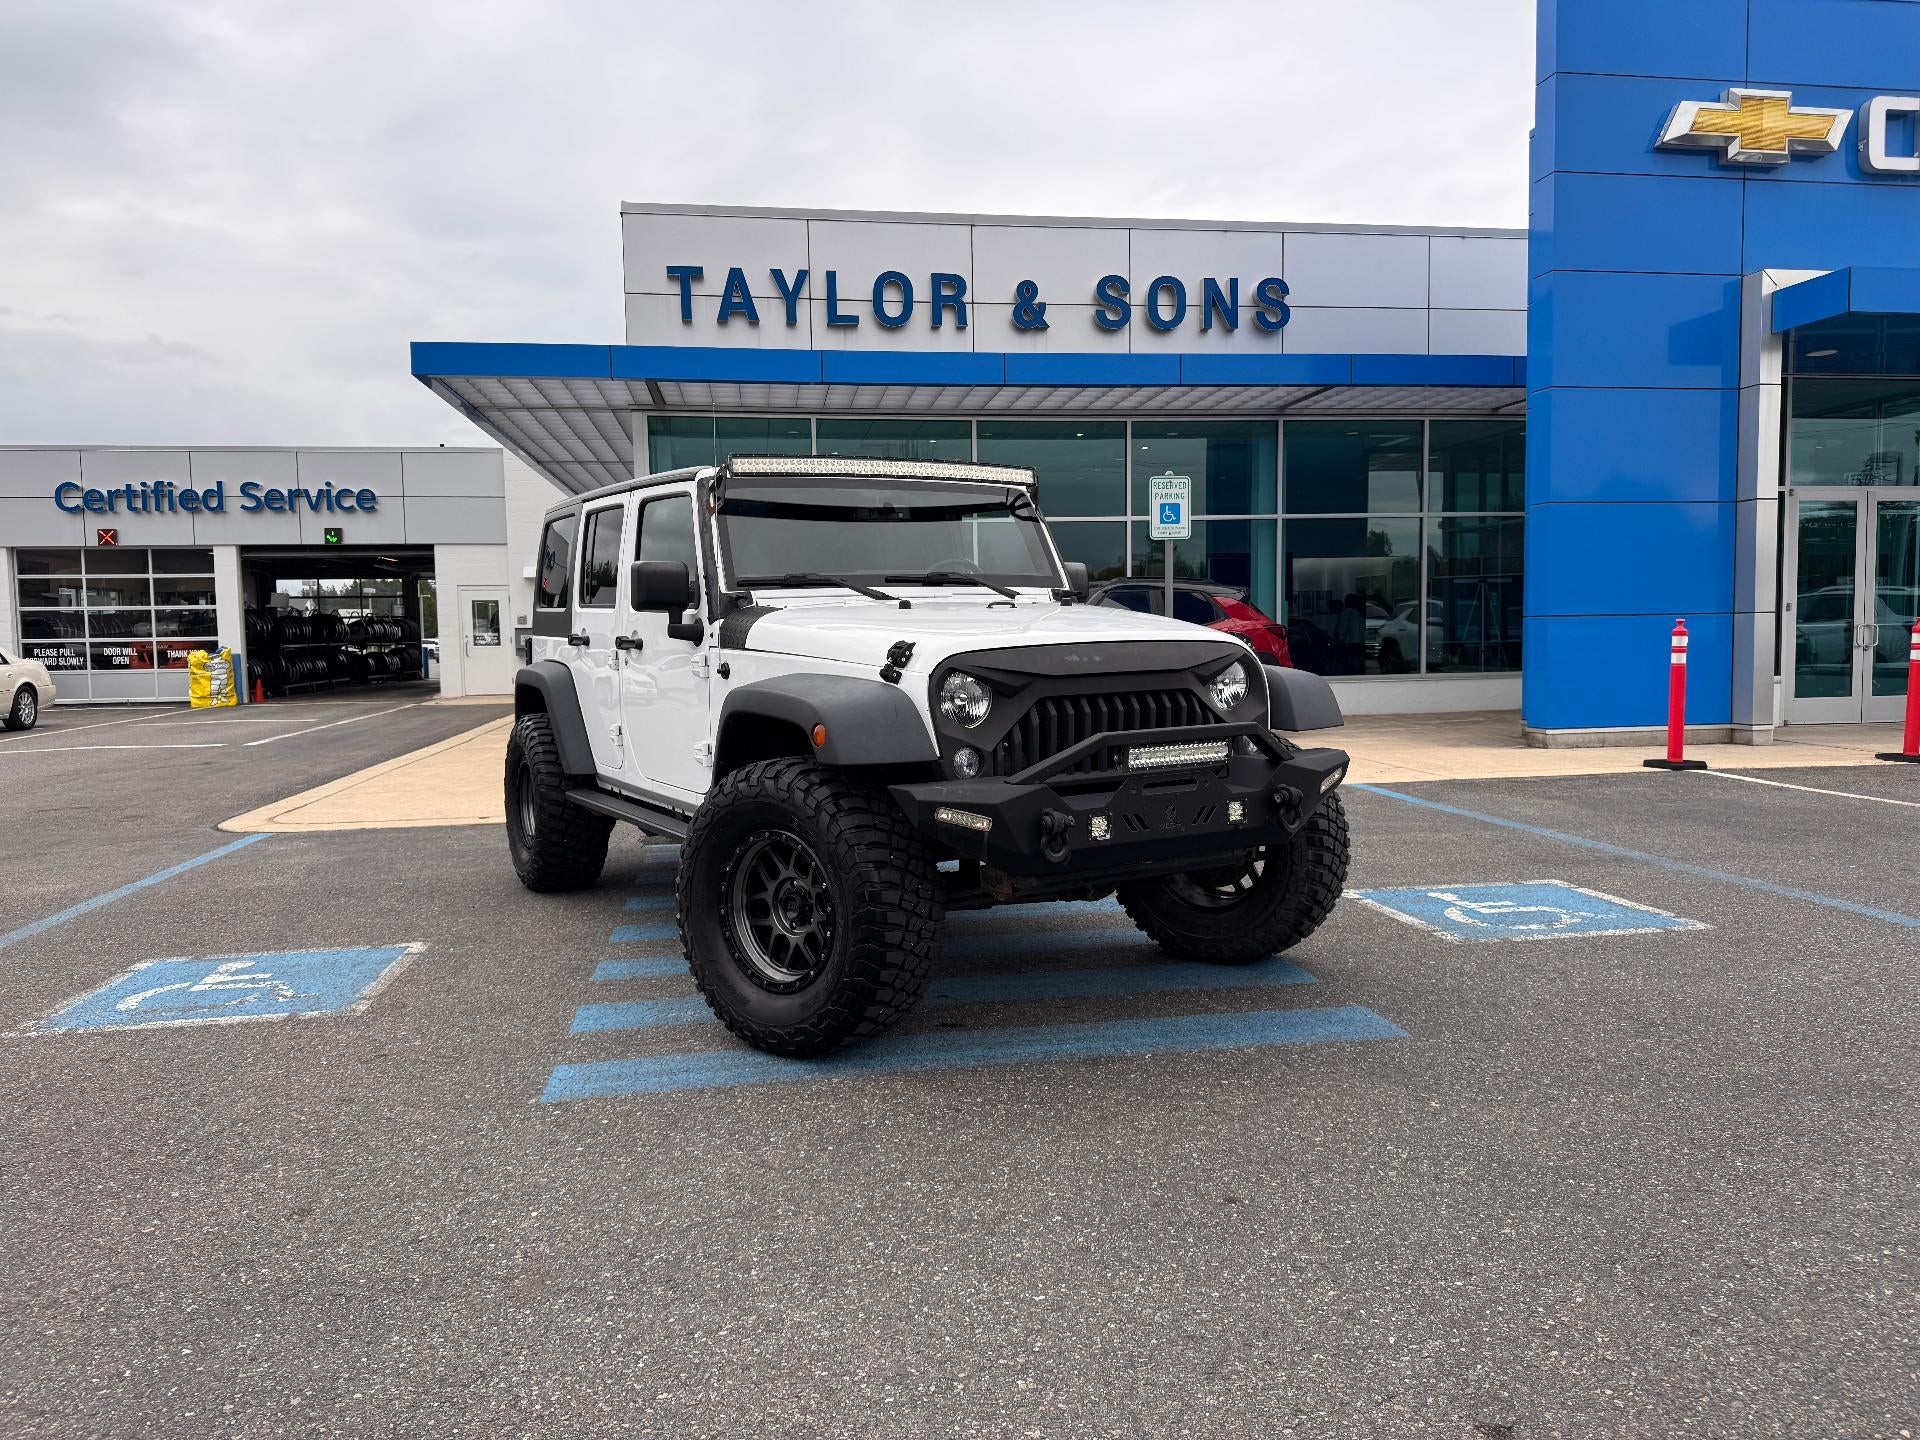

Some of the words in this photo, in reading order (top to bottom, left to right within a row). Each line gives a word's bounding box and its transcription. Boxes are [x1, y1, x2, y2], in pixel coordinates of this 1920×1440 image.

[666, 265, 969, 329] TAYLOR
[1011, 279, 1051, 331] &
[1094, 273, 1292, 332] SONS
[54, 480, 227, 513] Certified
[239, 481, 379, 513] Service
[1154, 492, 1185, 500] PARKING
[33, 648, 58, 657] PLEASE
[59, 648, 76, 657] PULL
[103, 647, 121, 656] DOOR
[122, 647, 139, 656] WILL
[166, 650, 188, 659] THANK
[58, 657, 84, 666] SLOWLY
[112, 656, 130, 665] OPEN
